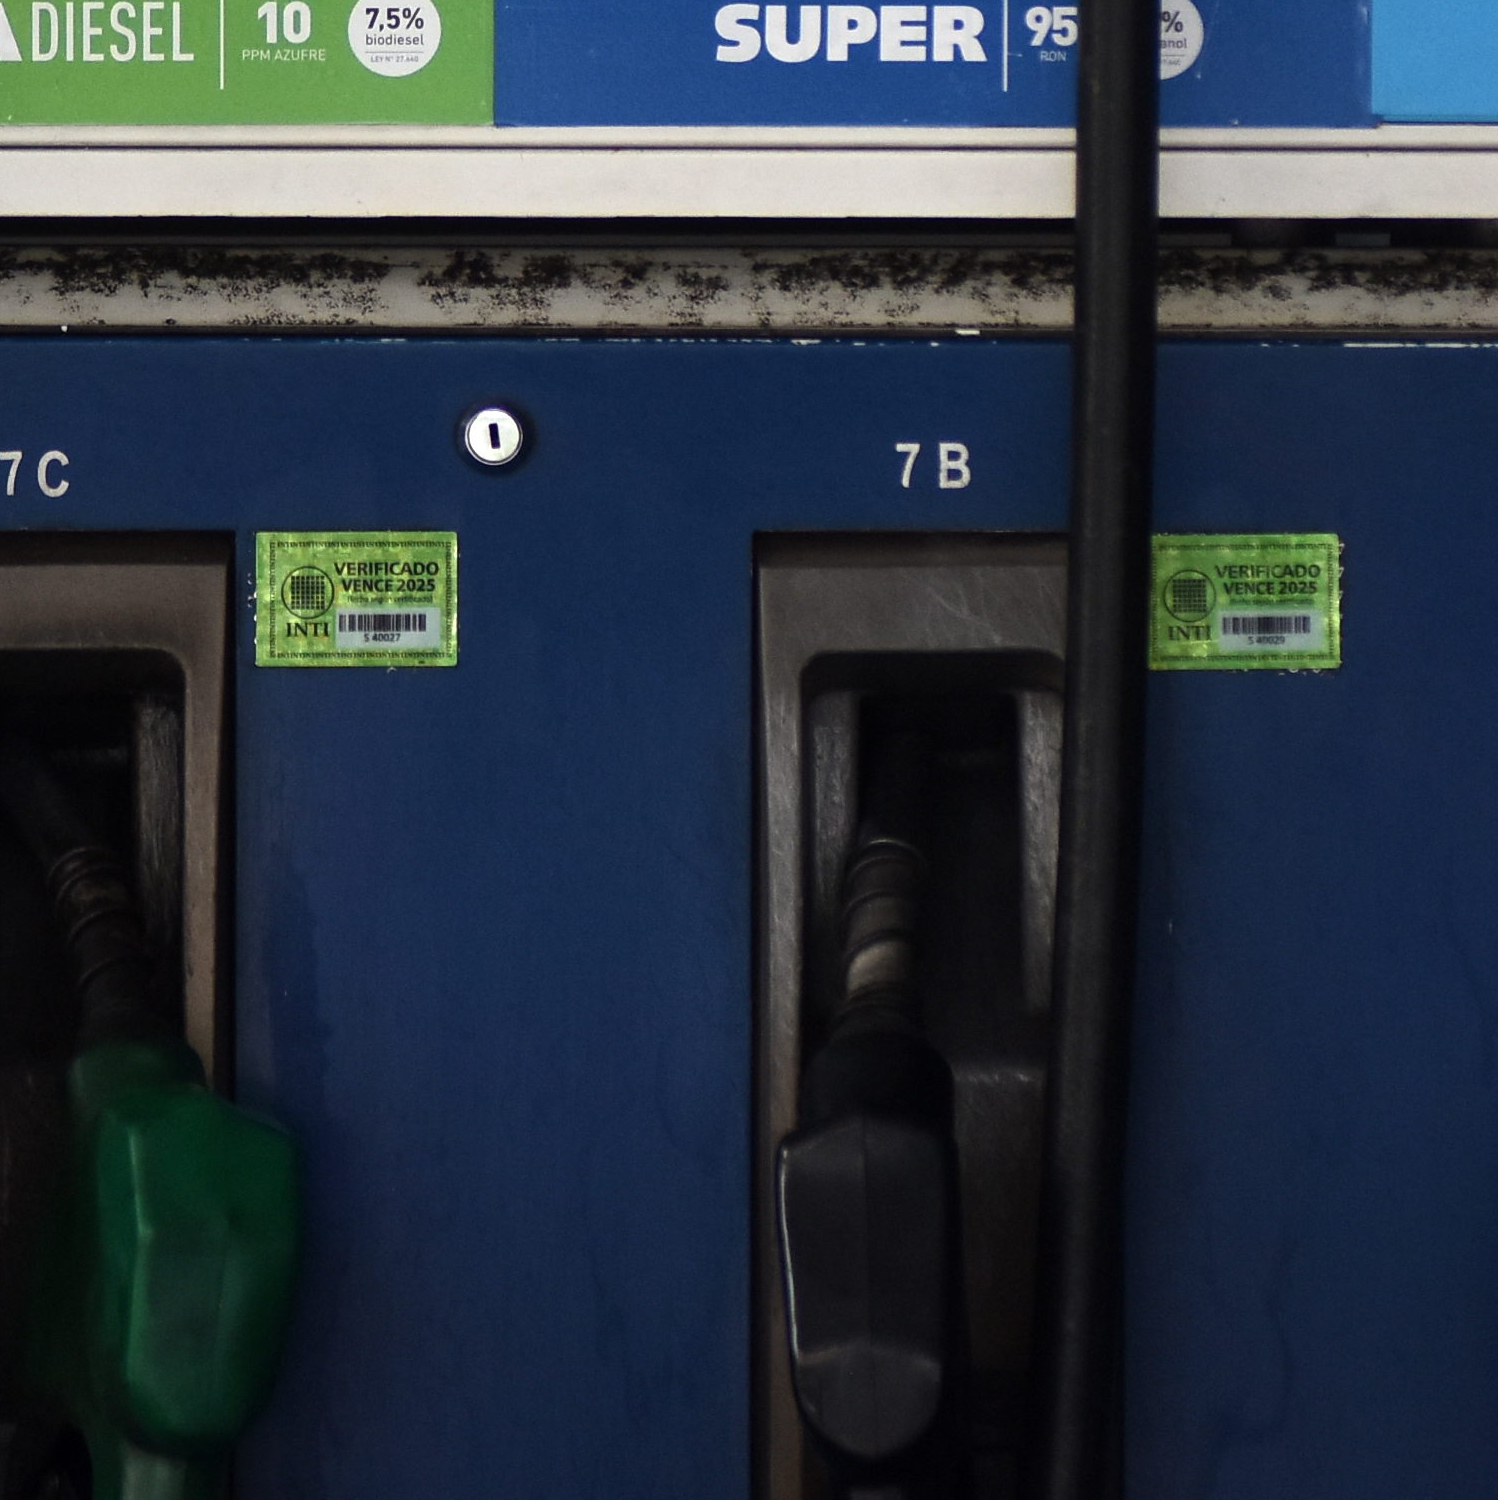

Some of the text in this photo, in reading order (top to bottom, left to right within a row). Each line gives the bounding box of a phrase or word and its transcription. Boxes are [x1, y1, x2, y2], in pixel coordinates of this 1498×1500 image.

[257, 0, 312, 44] 10
[364, 7, 425, 33] 7,5%
[1024, 5, 1079, 47] 95
[30, 0, 196, 62] DIESEL
[714, 3, 988, 63] SUPER
[364, 33, 425, 46] biodiesel
[241, 48, 327, 61] PPM AZUFRE
[334, 561, 440, 576] VERIFICADO
[1214, 564, 1321, 579] VERIFICADO
[341, 578, 436, 593] VENCE 2025
[1222, 581, 1318, 595] VENCE 2025
[286, 622, 330, 638] INTI
[1168, 625, 1213, 641] INTI
